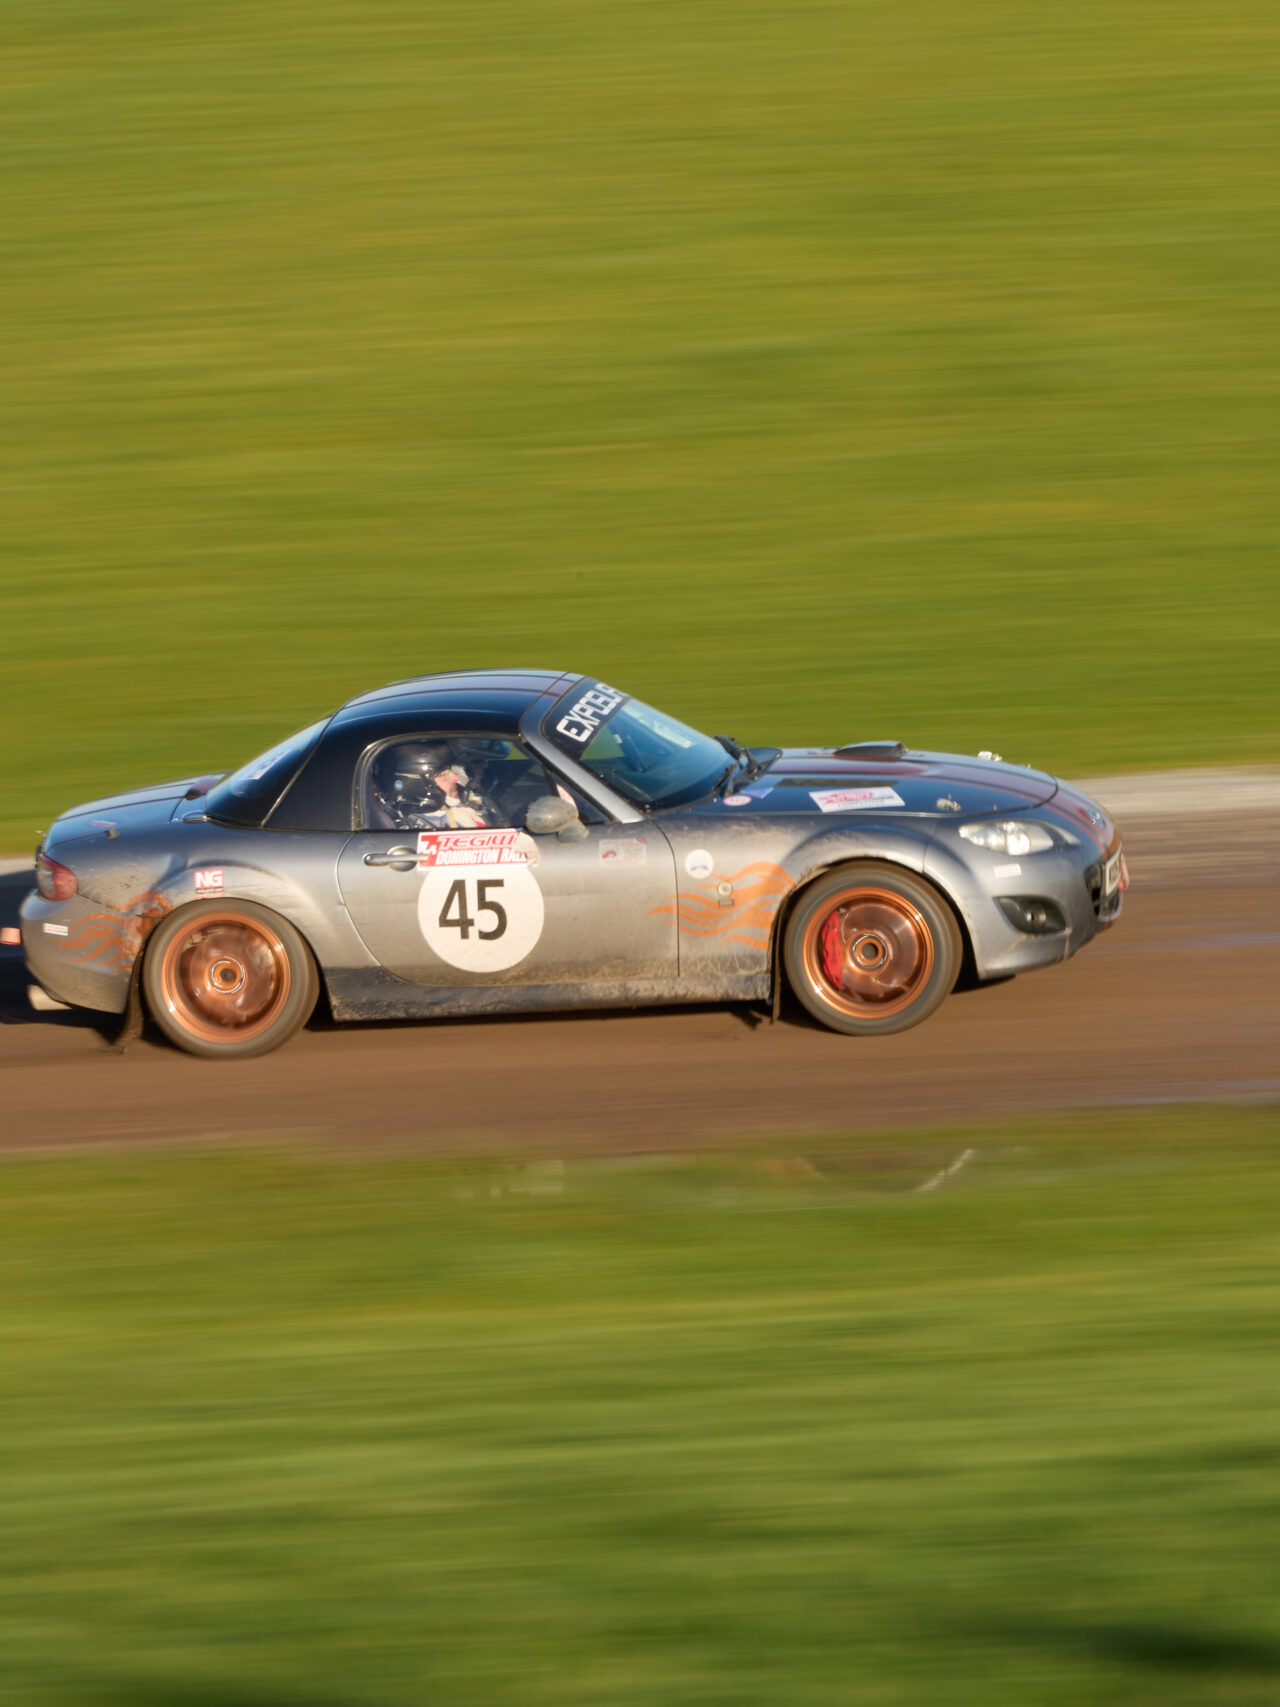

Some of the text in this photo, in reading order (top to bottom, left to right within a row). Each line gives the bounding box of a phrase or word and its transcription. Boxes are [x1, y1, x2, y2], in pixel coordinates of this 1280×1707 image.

[437, 833, 519, 850] TEGIW
[435, 848, 501, 865] DONINGTON
[195, 871, 222, 888] NG
[438, 879, 508, 941] 45
